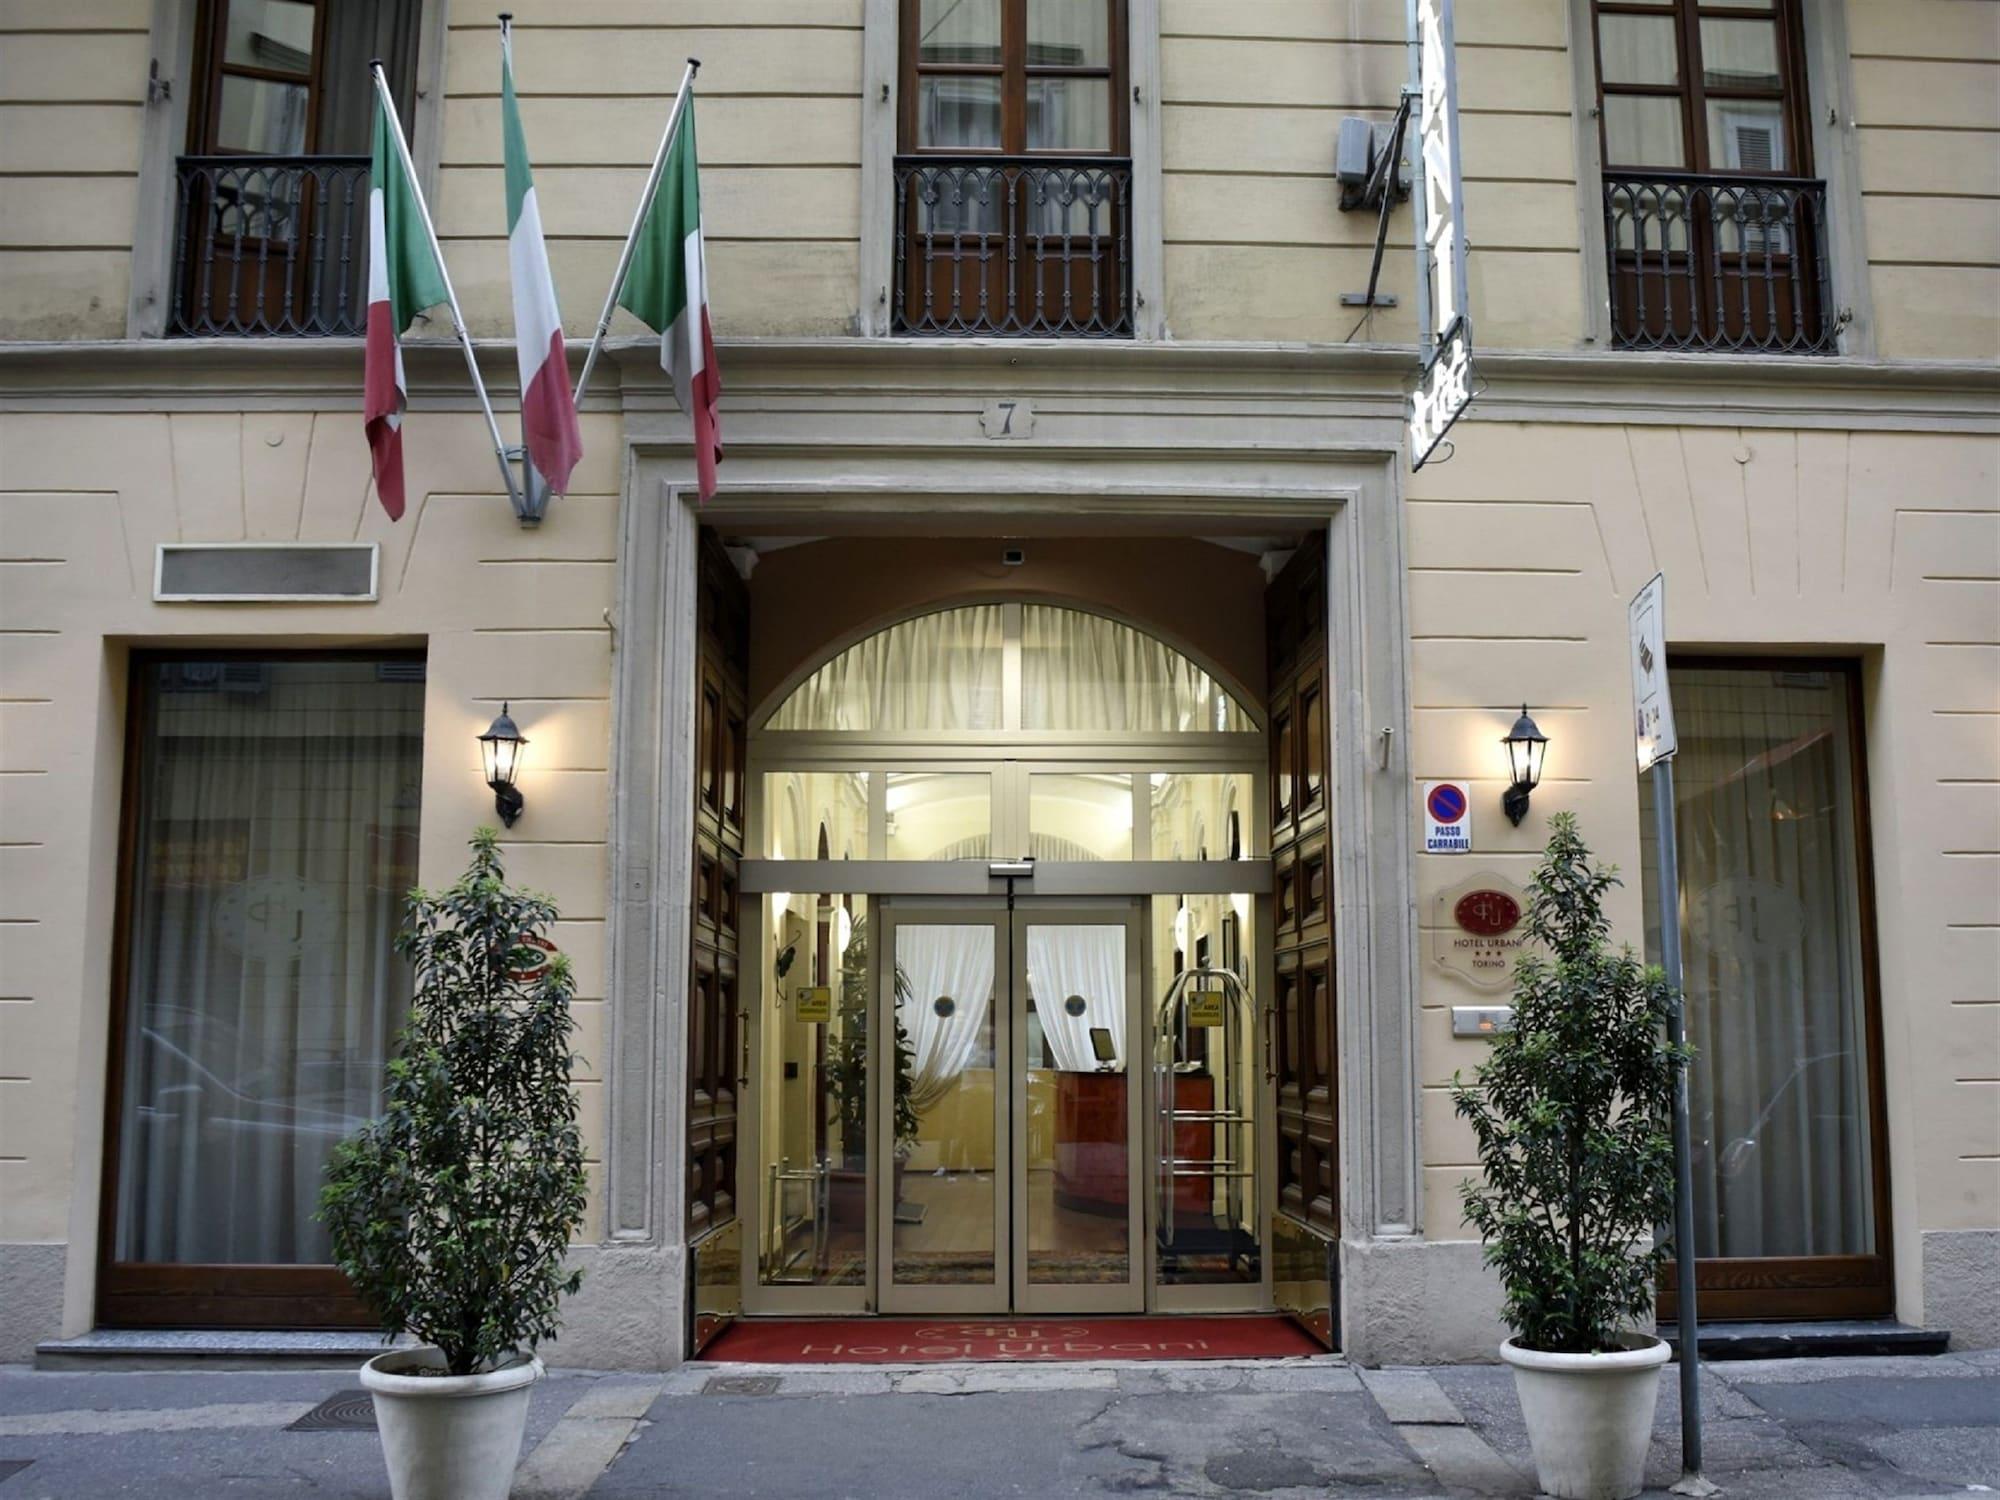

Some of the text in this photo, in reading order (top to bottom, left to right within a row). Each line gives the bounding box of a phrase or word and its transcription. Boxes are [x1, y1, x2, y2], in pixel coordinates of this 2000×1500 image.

[998, 403, 1017, 434] 7
[1435, 826, 1461, 837] PASSO
[1428, 839, 1469, 849] CARRABILE
[1454, 939, 1484, 948] HOTEL
[1472, 960, 1506, 968] TORINO
[801, 1339, 1209, 1355] Hotel Urbani
